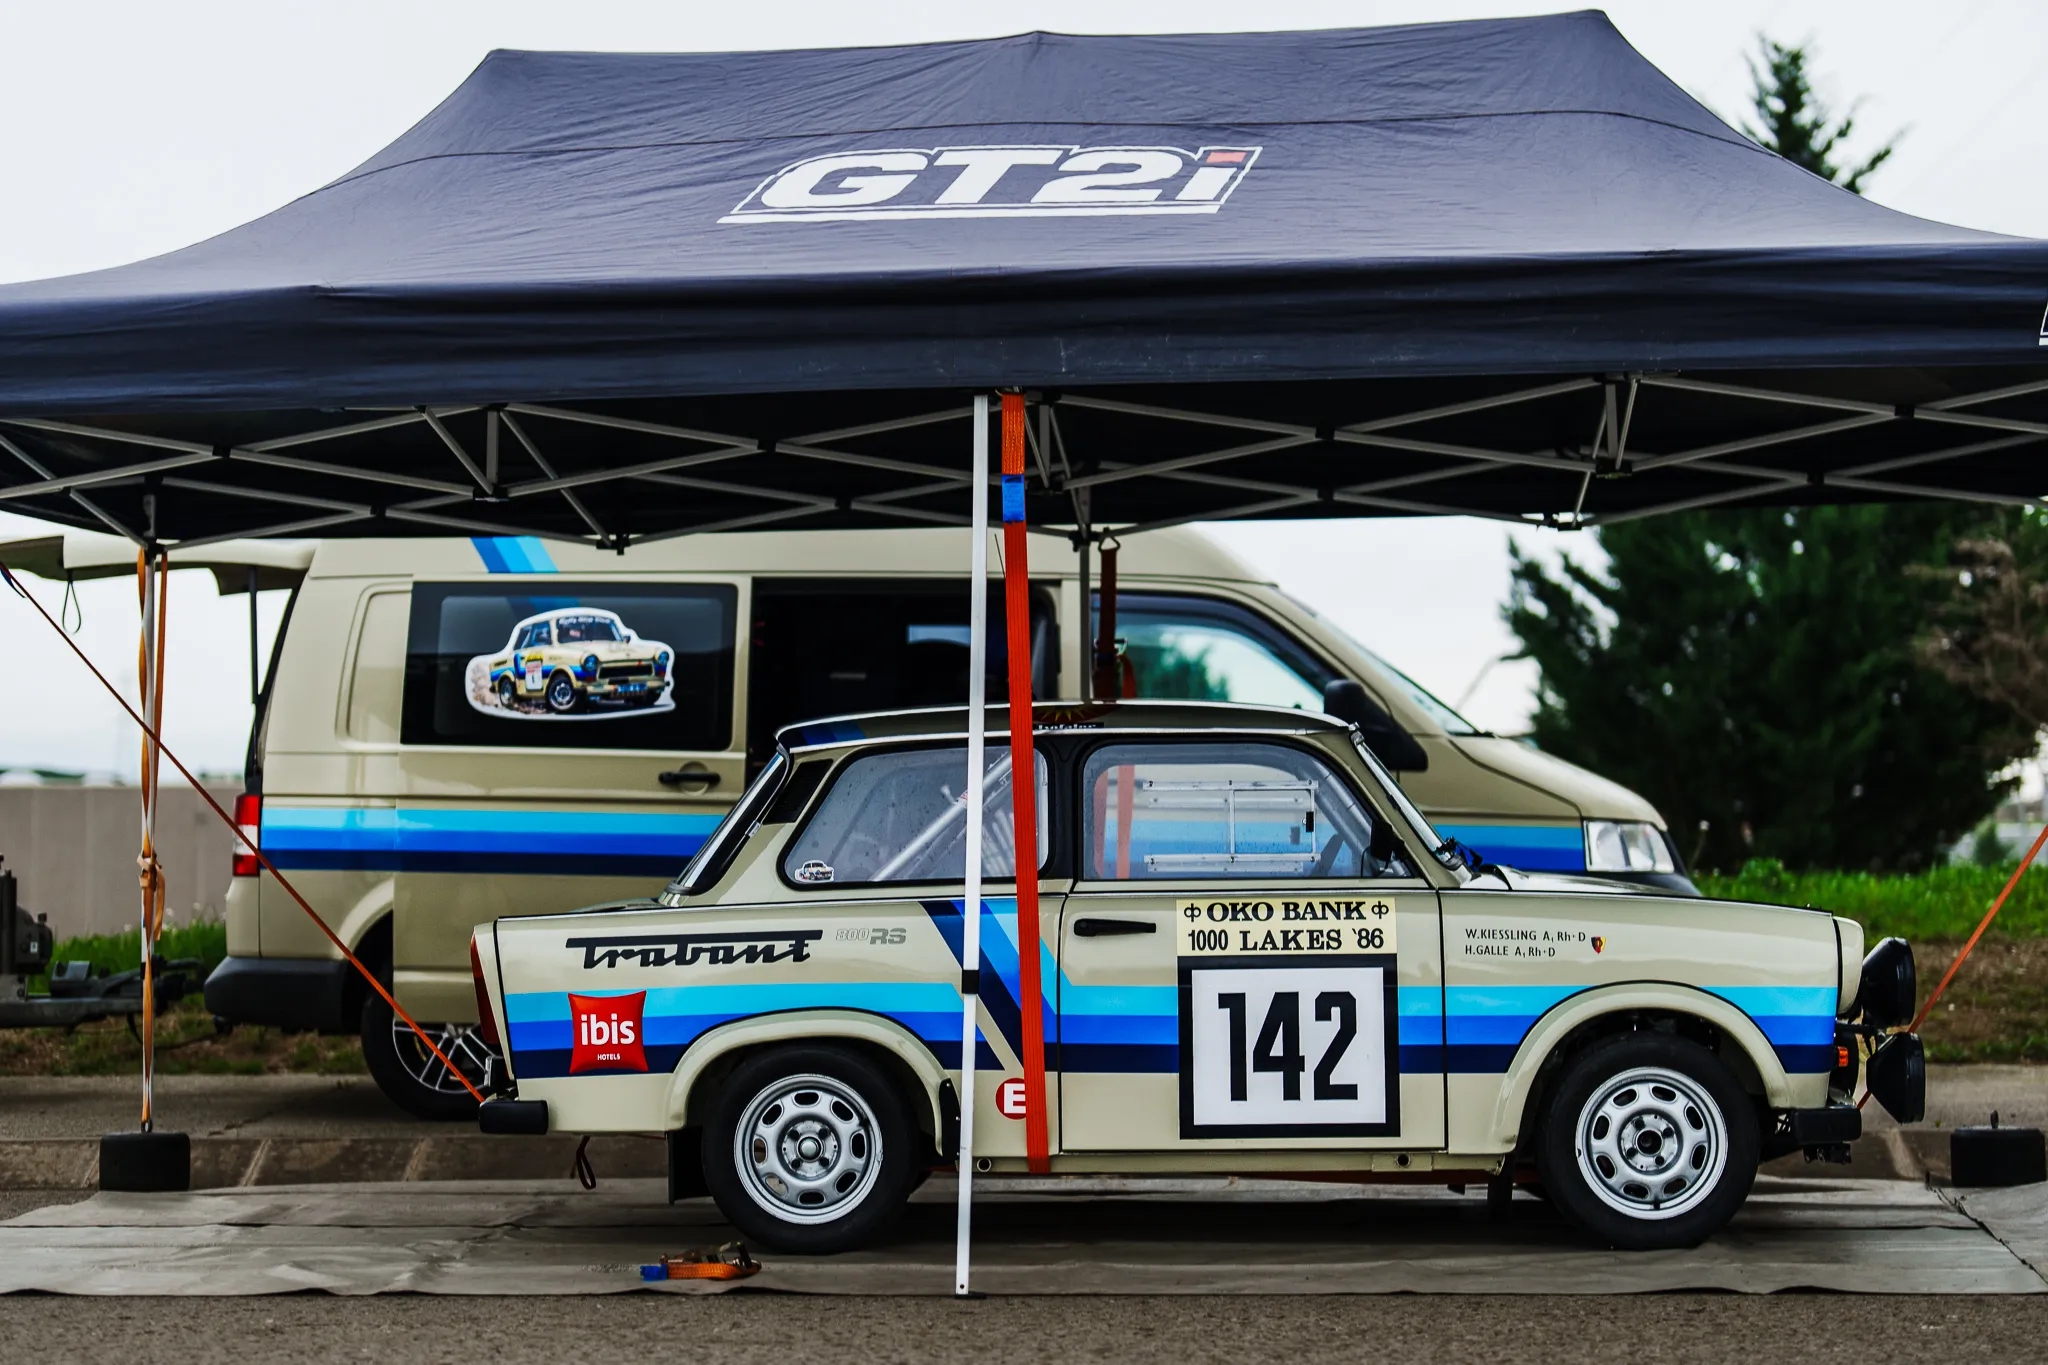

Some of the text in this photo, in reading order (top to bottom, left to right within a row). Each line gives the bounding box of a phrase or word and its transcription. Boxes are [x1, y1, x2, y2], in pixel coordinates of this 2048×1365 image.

[758, 147, 1250, 209] GT2i
[1207, 901, 1366, 922] OKO BANK
[565, 929, 823, 969] Trabant
[1188, 929, 1229, 951] 1000
[1239, 929, 1342, 951] LAKES
[581, 1013, 635, 1046] ibis
[597, 1053, 621, 1061] HOTELS
[1218, 991, 1358, 1101] 142
[1003, 1083, 1026, 1113] E
